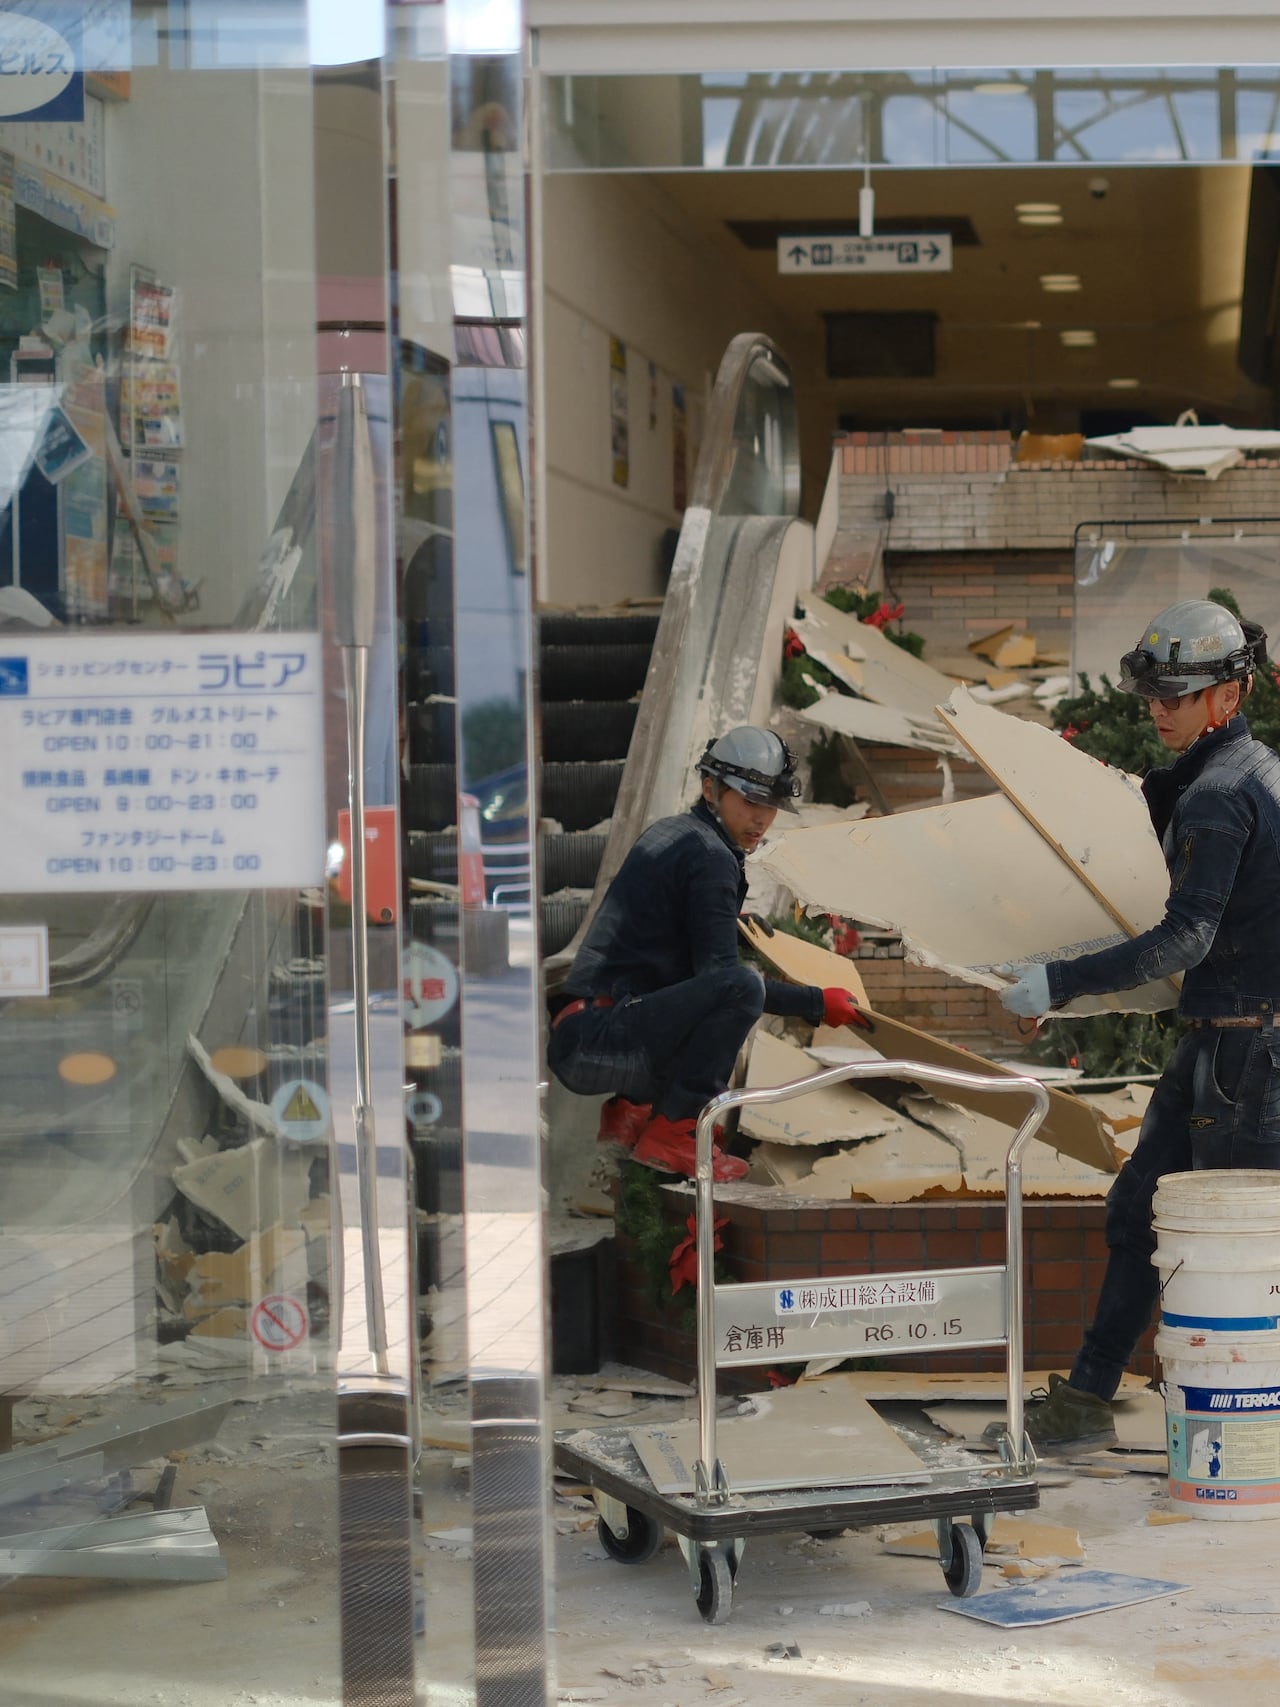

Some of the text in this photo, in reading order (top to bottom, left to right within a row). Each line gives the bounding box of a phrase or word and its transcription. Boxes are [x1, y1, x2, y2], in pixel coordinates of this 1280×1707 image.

[36, 650, 306, 690] ショッピングセンター ラピア
[151, 704, 280, 724] グルメストリート
[43, 734, 97, 752] OPEN
[45, 796, 101, 813] OPEN
[80, 829, 226, 847] ファンタジードーム
[46, 856, 101, 875] OPEN
[798, 1280, 936, 1311] (株)成田総合設備
[723, 1323, 787, 1353] 倉庫用
